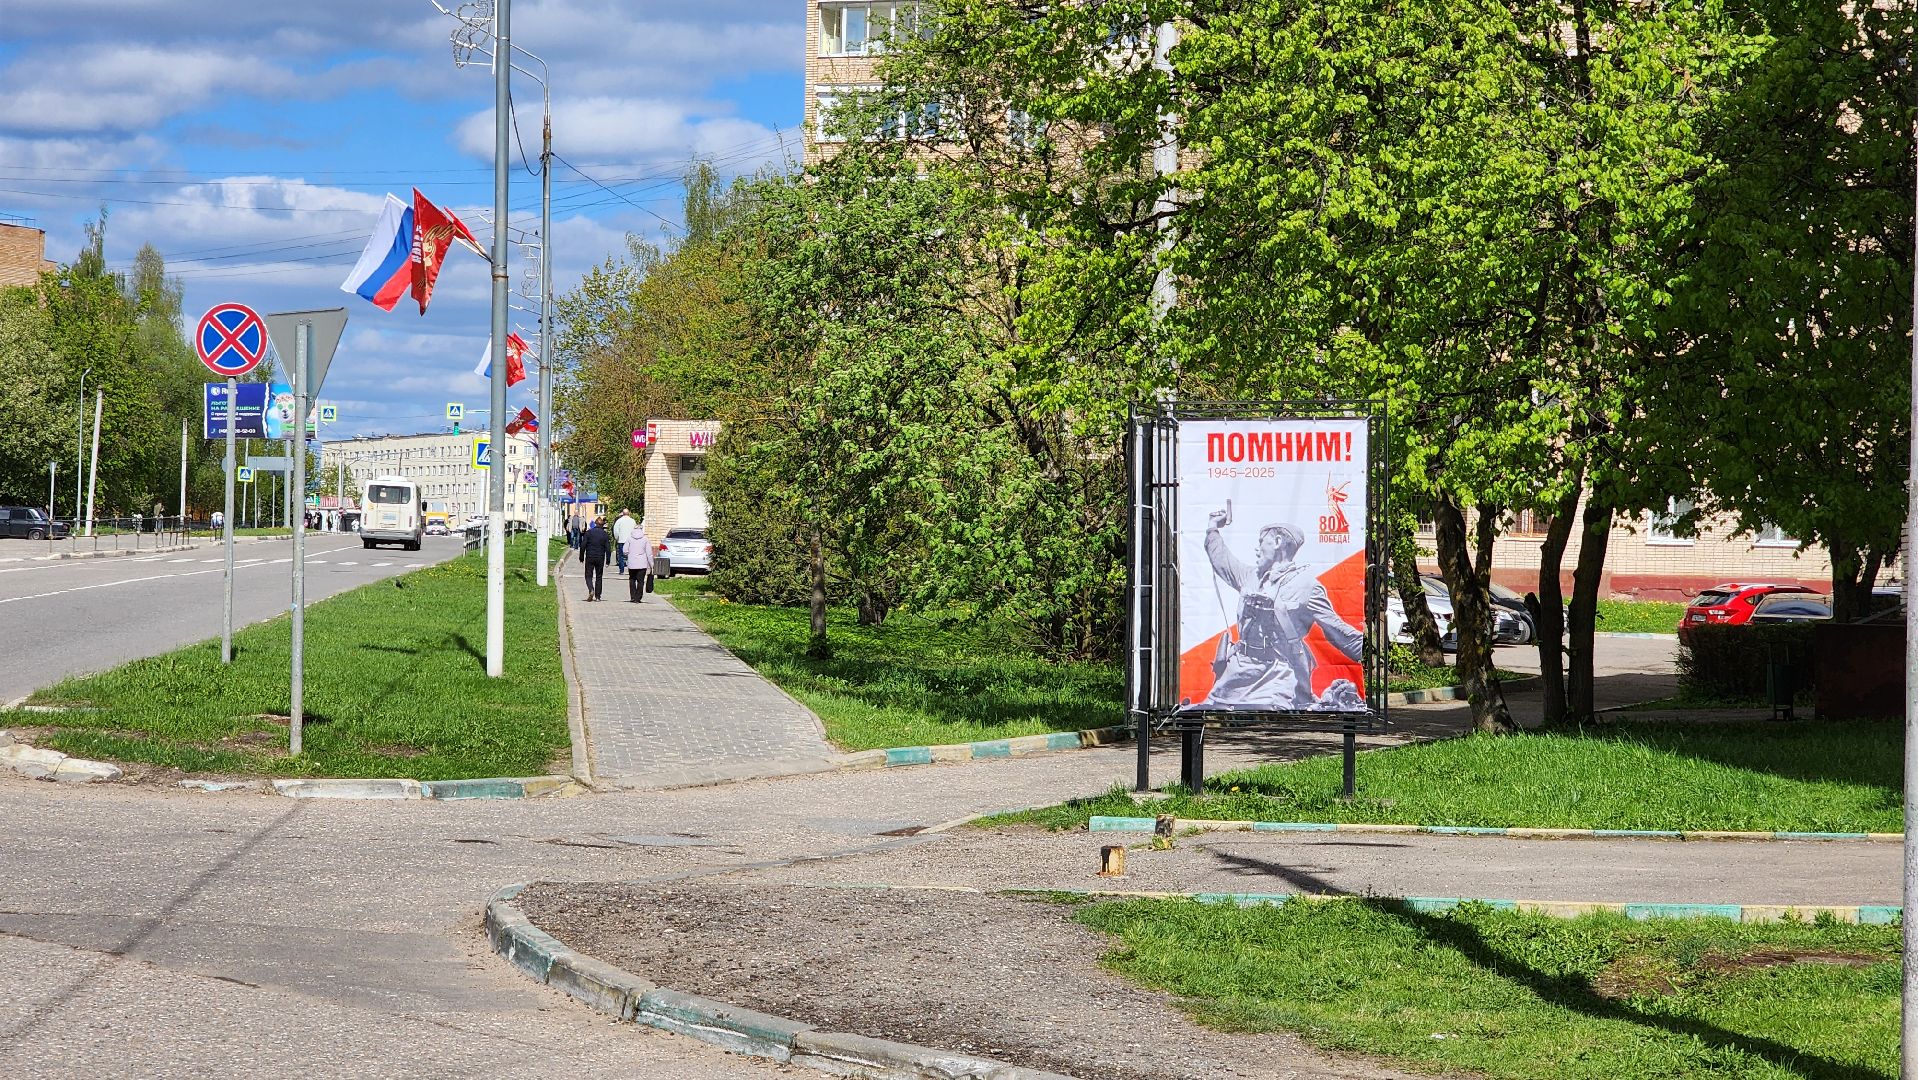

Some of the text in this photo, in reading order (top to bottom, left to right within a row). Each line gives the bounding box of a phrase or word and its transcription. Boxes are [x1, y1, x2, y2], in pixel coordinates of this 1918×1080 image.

[1207, 432, 1352, 463] ПОМНИМ!
[1320, 515, 1336, 532] 80
[1319, 534, 1350, 544] ПОБЕДА!
